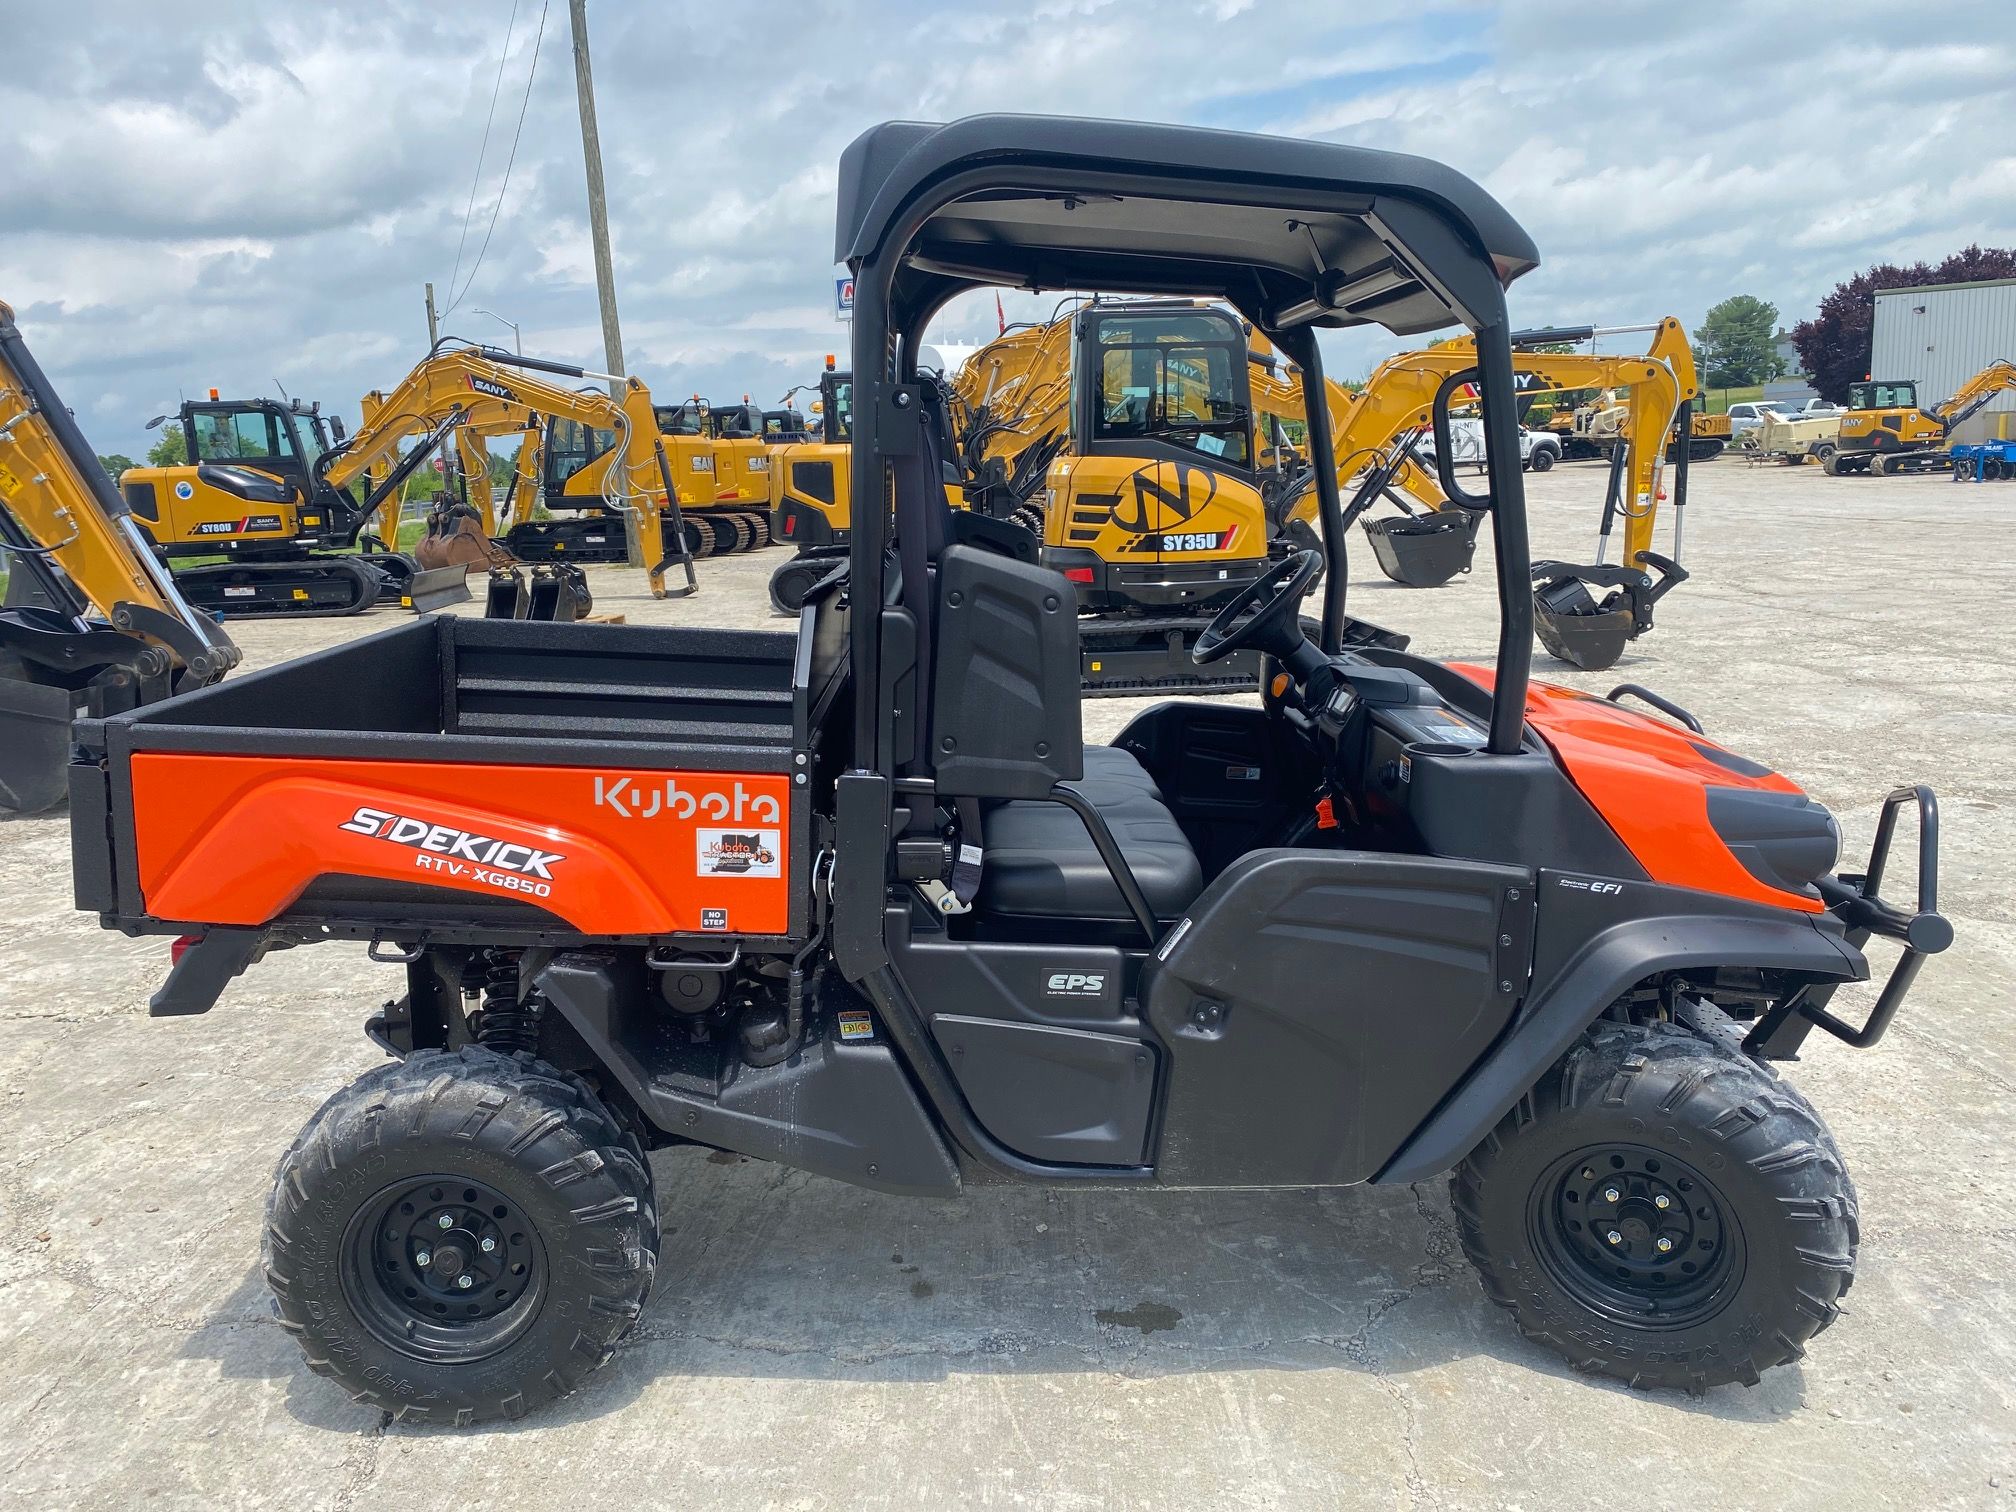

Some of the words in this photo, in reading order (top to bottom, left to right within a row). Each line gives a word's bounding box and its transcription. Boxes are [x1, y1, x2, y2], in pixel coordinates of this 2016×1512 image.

[475, 380, 508, 396] SANY
[202, 523, 231, 533] SY80U
[1163, 533, 1217, 551] SY35U
[594, 777, 780, 823] Kubota
[338, 807, 567, 880] SIDEKICK
[710, 841, 750, 852] Kubota
[709, 851, 752, 859] TRACTOR
[415, 854, 551, 897] RTV-XG850
[1590, 882, 1622, 895] EFI
[1048, 974, 1104, 990] EPS
